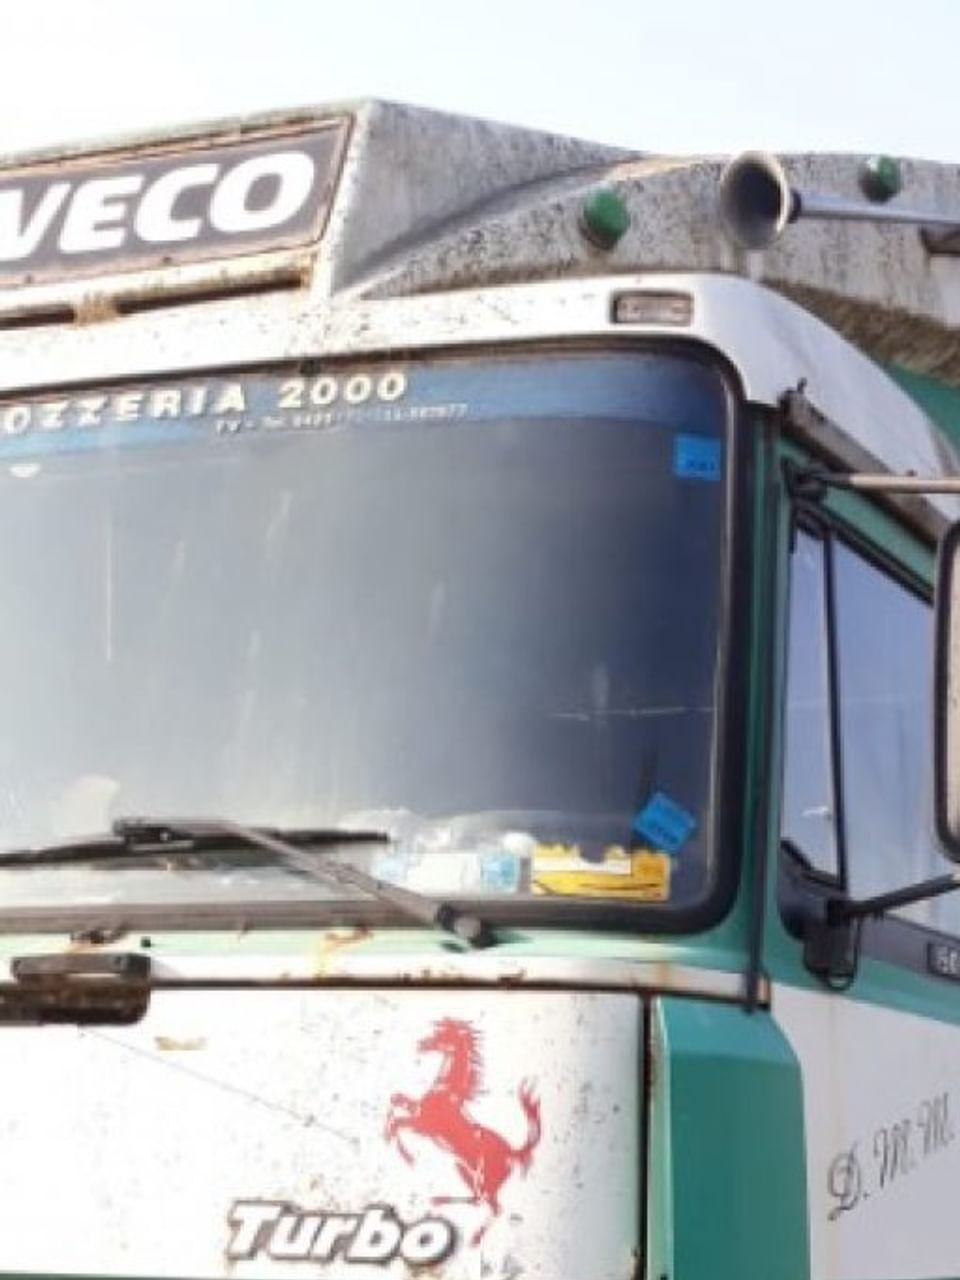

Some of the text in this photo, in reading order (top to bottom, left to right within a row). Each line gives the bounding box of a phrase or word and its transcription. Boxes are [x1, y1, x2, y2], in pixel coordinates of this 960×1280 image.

[0, 153, 315, 261] VECO
[278, 372, 408, 409] 2000
[226, 1199, 459, 1265] Turbo
